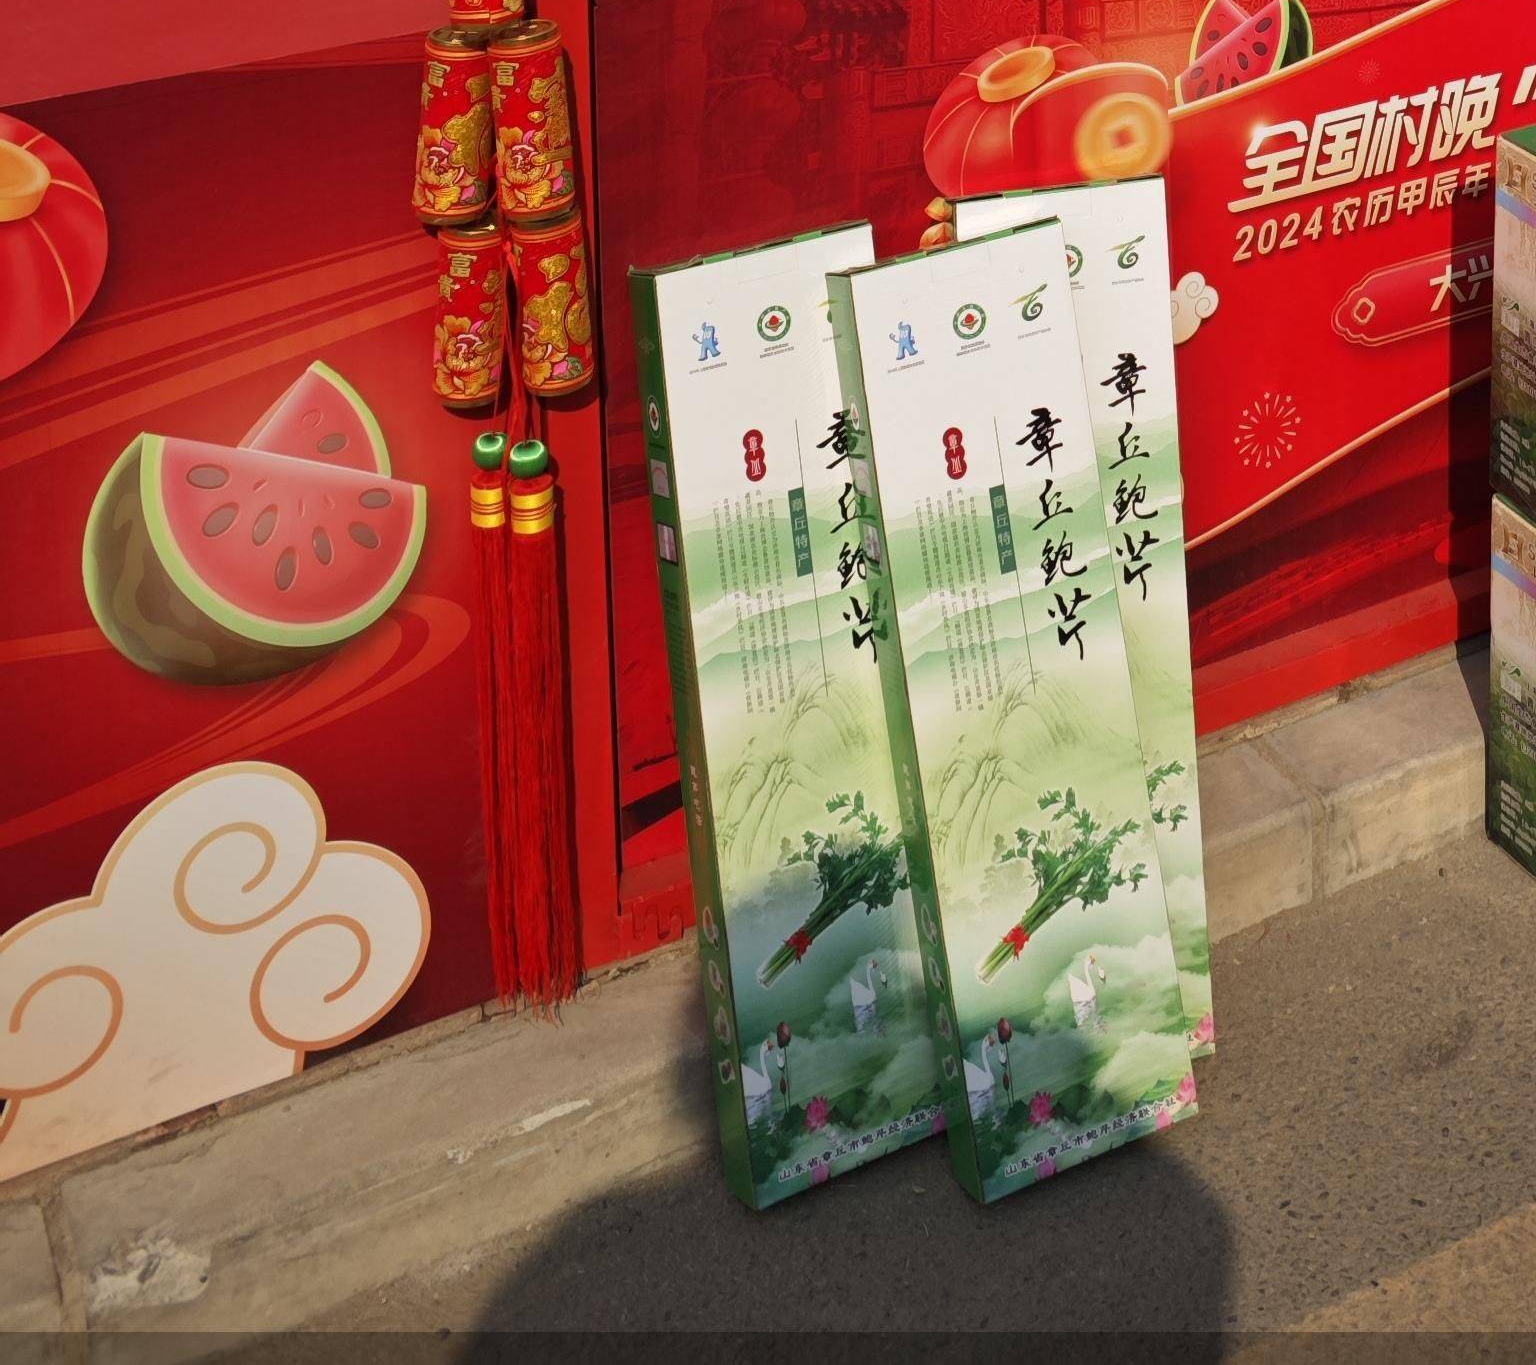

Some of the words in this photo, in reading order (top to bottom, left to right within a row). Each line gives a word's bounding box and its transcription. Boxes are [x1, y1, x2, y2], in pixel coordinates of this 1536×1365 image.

[1228, 74, 1503, 213] 全国村晚
[1233, 205, 1322, 263] 2024
[1330, 161, 1492, 235] 农历甲辰年
[1100, 352, 1161, 602] 章丘鲍芹
[791, 497, 810, 569] 章丘特产
[992, 494, 1014, 567] 章丘特产
[1015, 407, 1093, 661] 章丘鲍芹
[779, 1104, 945, 1181] 山东省章丘市鲍芹经济联合
